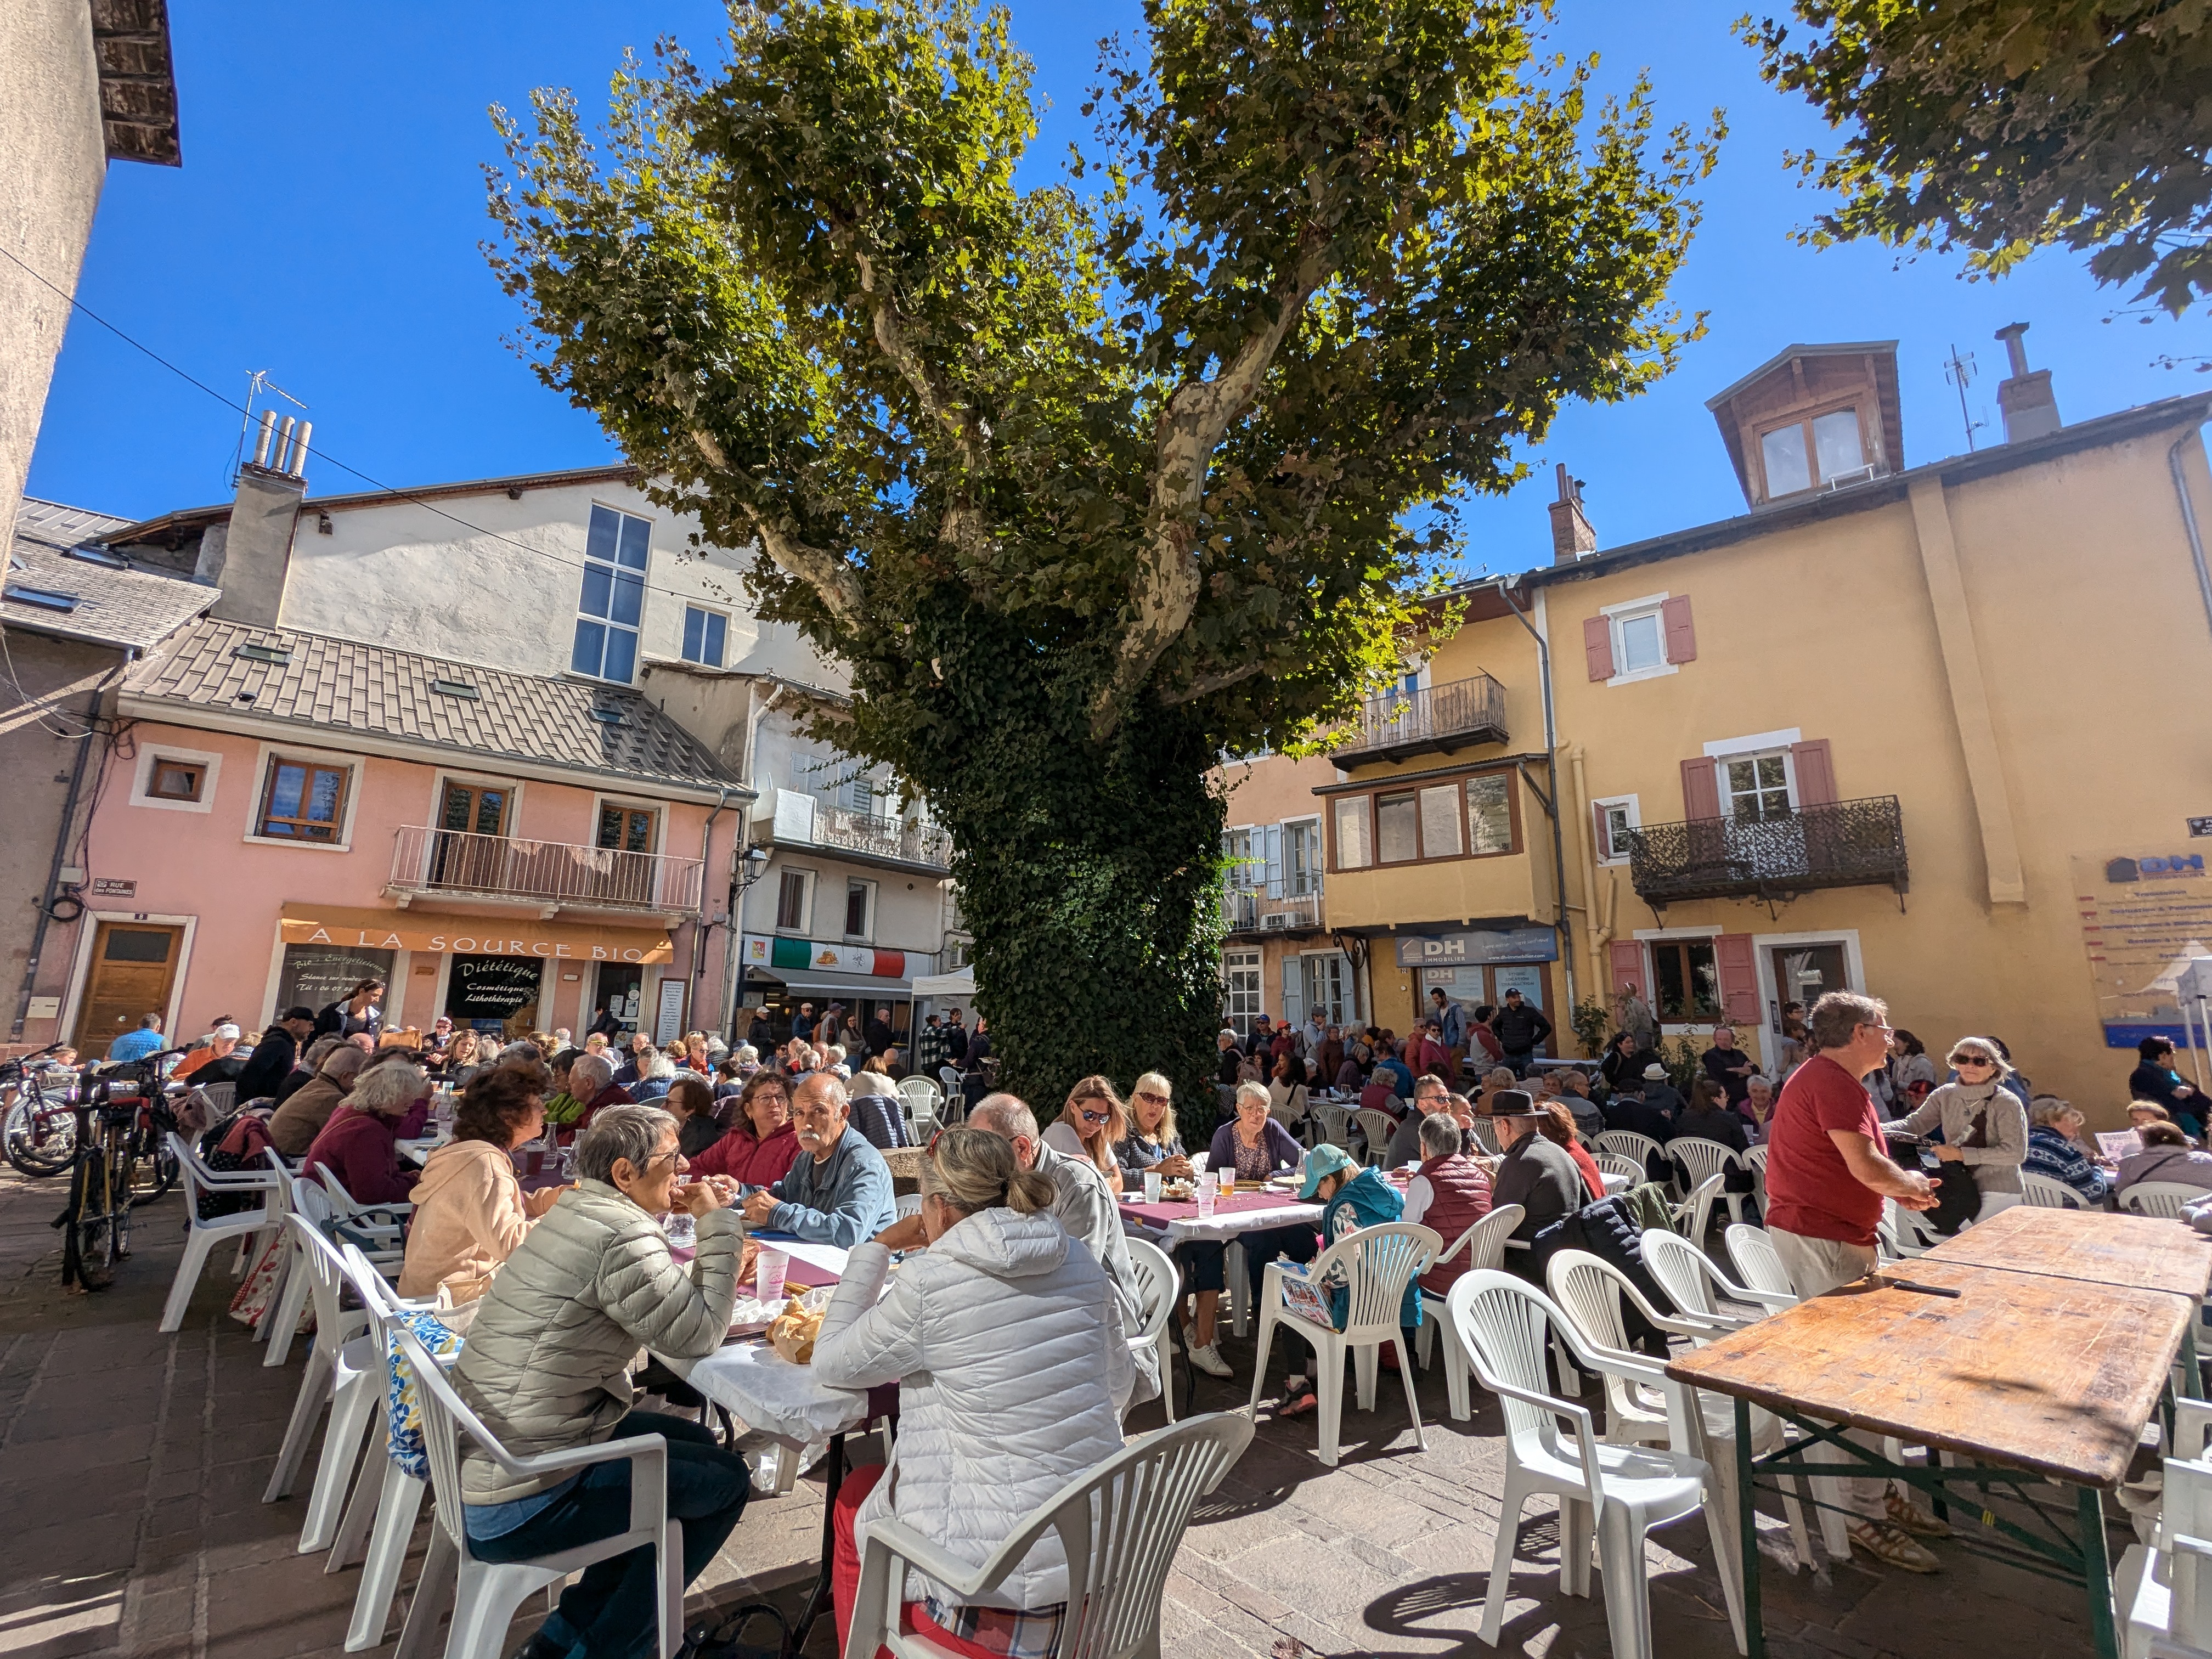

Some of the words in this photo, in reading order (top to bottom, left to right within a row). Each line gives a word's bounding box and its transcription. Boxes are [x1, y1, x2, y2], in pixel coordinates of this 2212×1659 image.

[2140, 854, 2204, 873] DH
[308, 928, 332, 943] A
[358, 931, 403, 949] LA
[427, 936, 571, 957] SOURCE
[592, 946, 642, 961] BIO
[1424, 940, 1465, 955] DH
[294, 960, 312, 969] Bio
[456, 960, 538, 980] Diététique
[1427, 969, 1453, 979] DH
[466, 983, 524, 994] Cosmétique
[465, 994, 523, 1005] Lithothérapie
